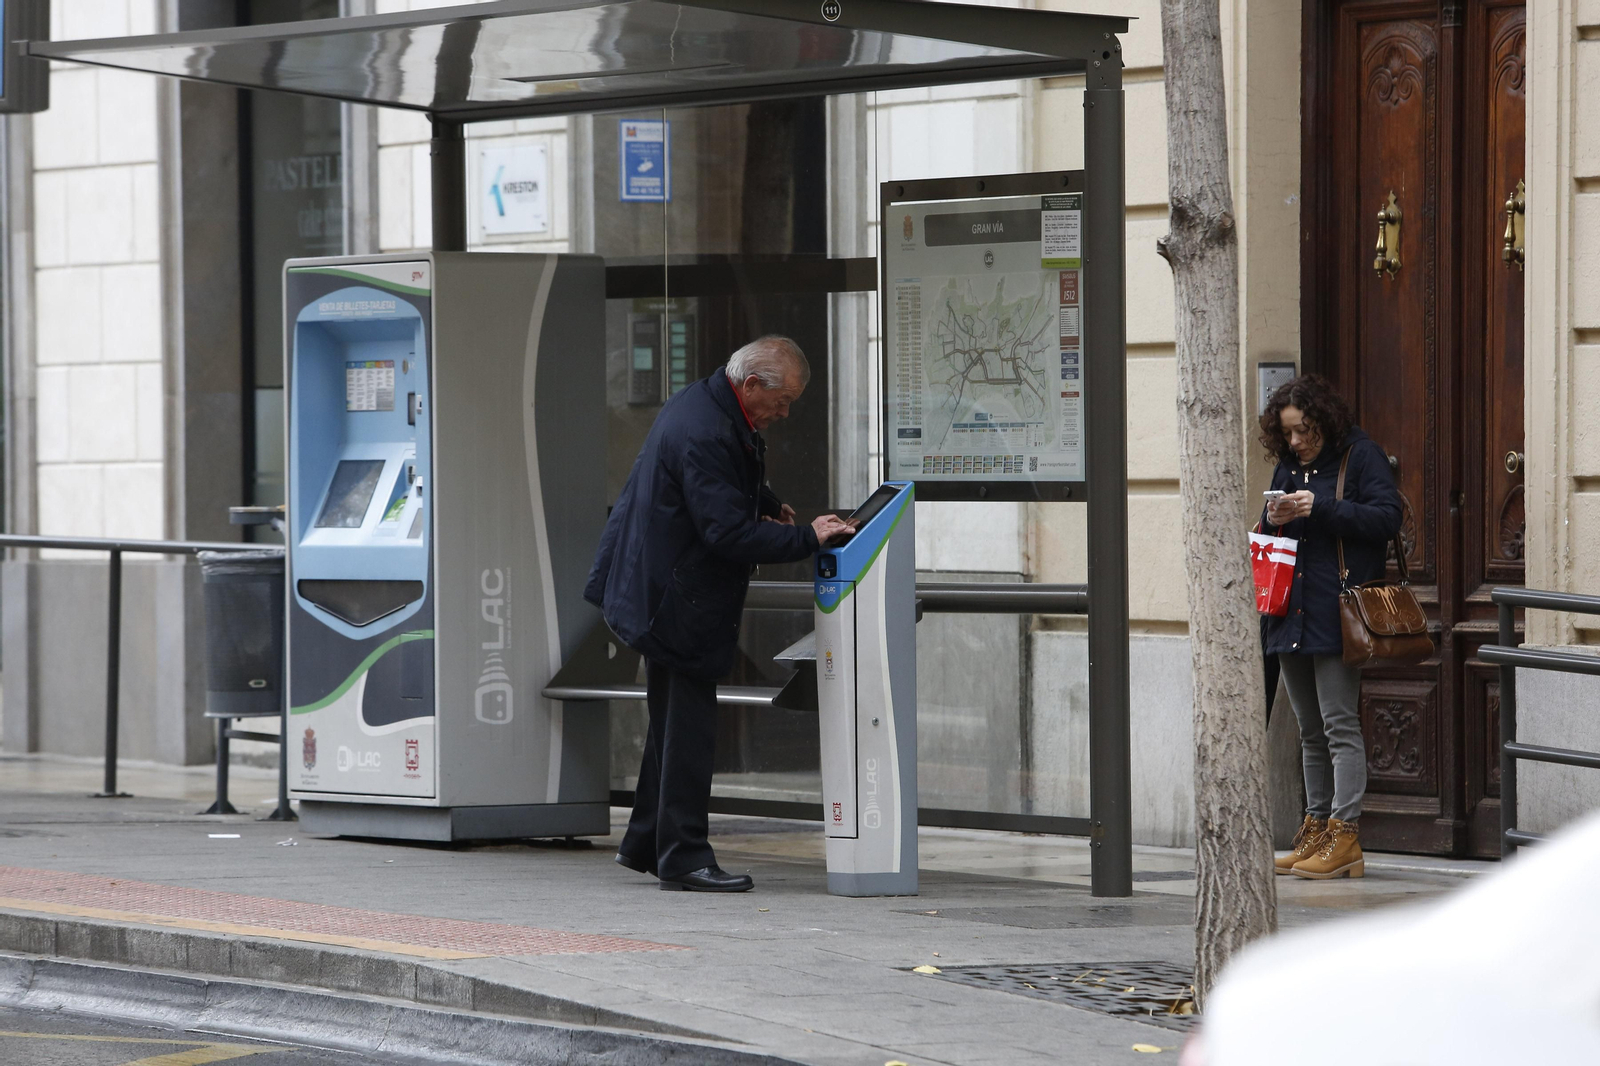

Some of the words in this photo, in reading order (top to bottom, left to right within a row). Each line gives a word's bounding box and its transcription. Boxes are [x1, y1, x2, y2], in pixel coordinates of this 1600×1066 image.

[825, 6, 837, 14] 111
[971, 223, 991, 234] GRAN
[992, 220, 1004, 233] VÍA
[318, 302, 335, 311] VENTA
[336, 302, 344, 311] DE
[481, 568, 504, 649] LAC
[358, 752, 381, 767] LAC
[866, 758, 877, 795] LAC
